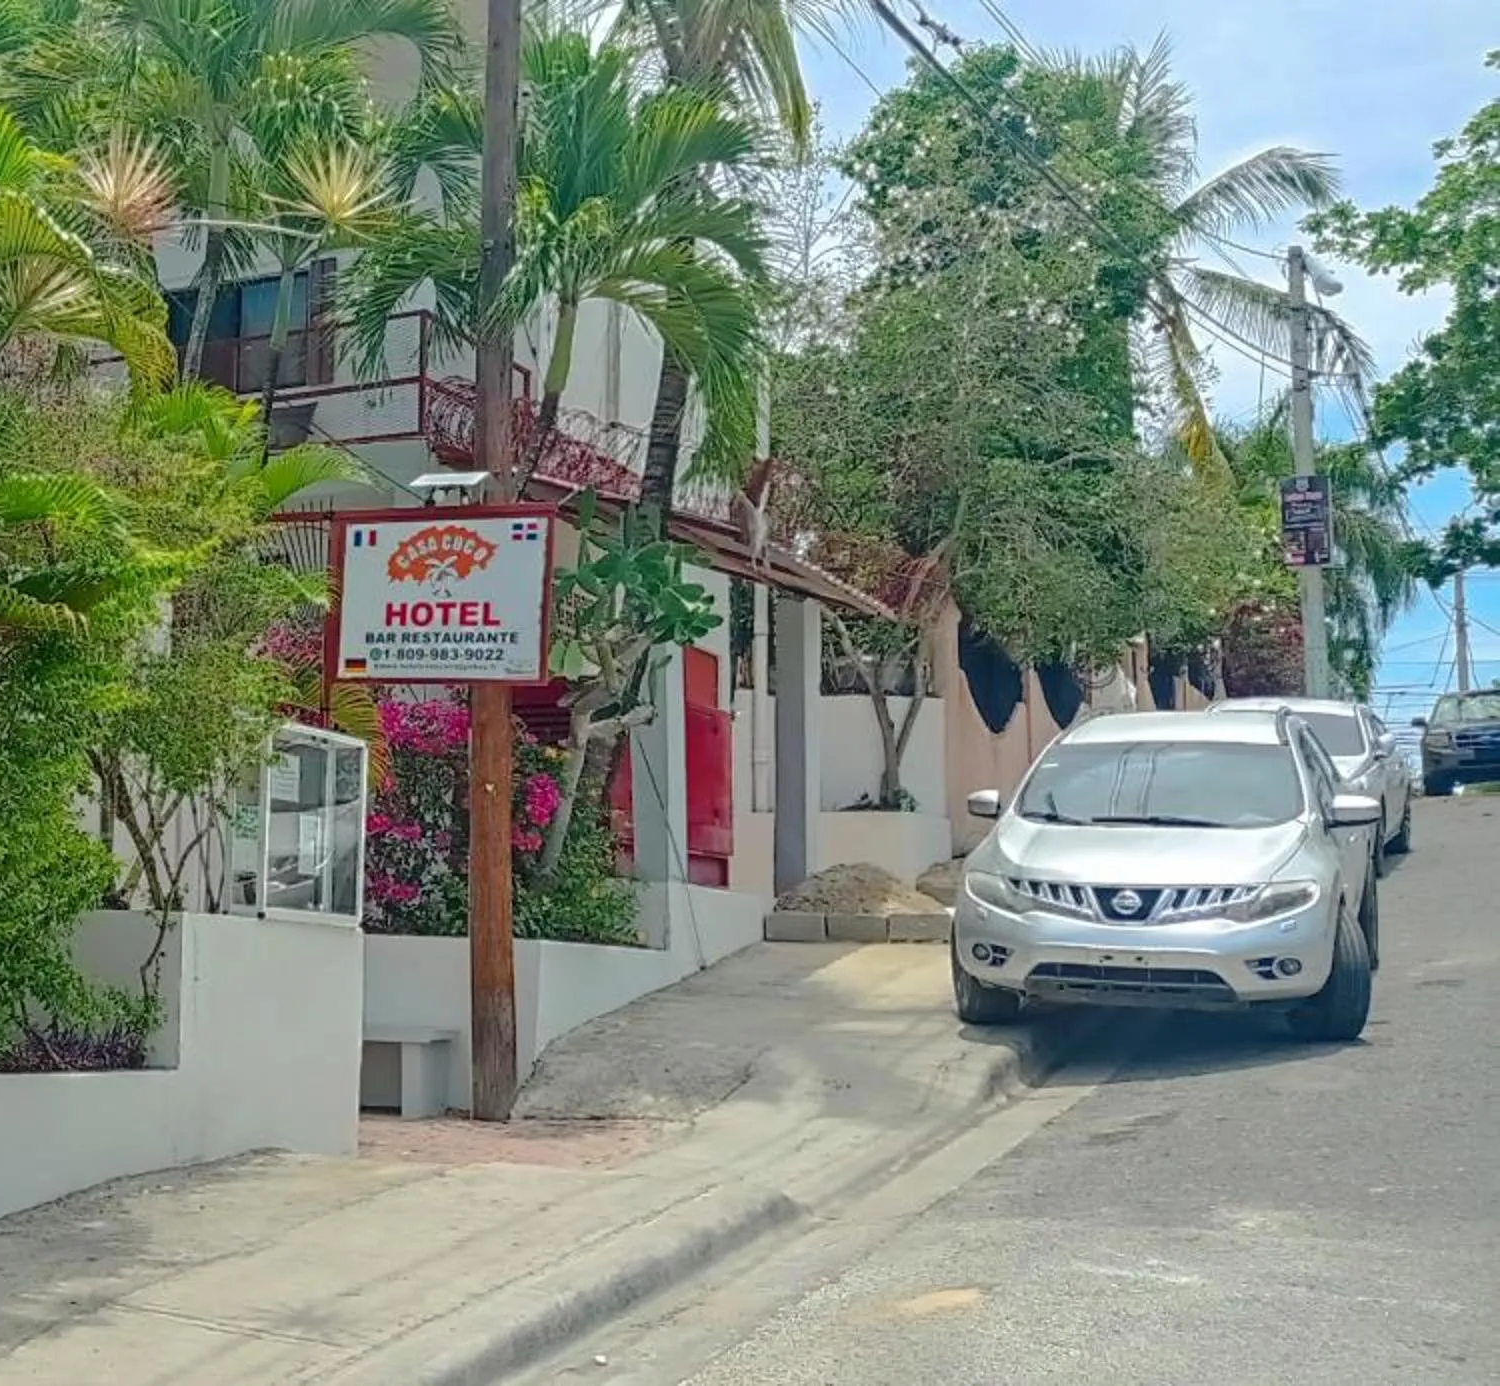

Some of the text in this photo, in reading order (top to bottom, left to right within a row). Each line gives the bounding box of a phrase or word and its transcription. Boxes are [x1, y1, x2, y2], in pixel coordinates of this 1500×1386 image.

[396, 535, 438, 569] CASA
[385, 602, 500, 626] HOTEL
[365, 631, 519, 644] BAR RESTAURANTE
